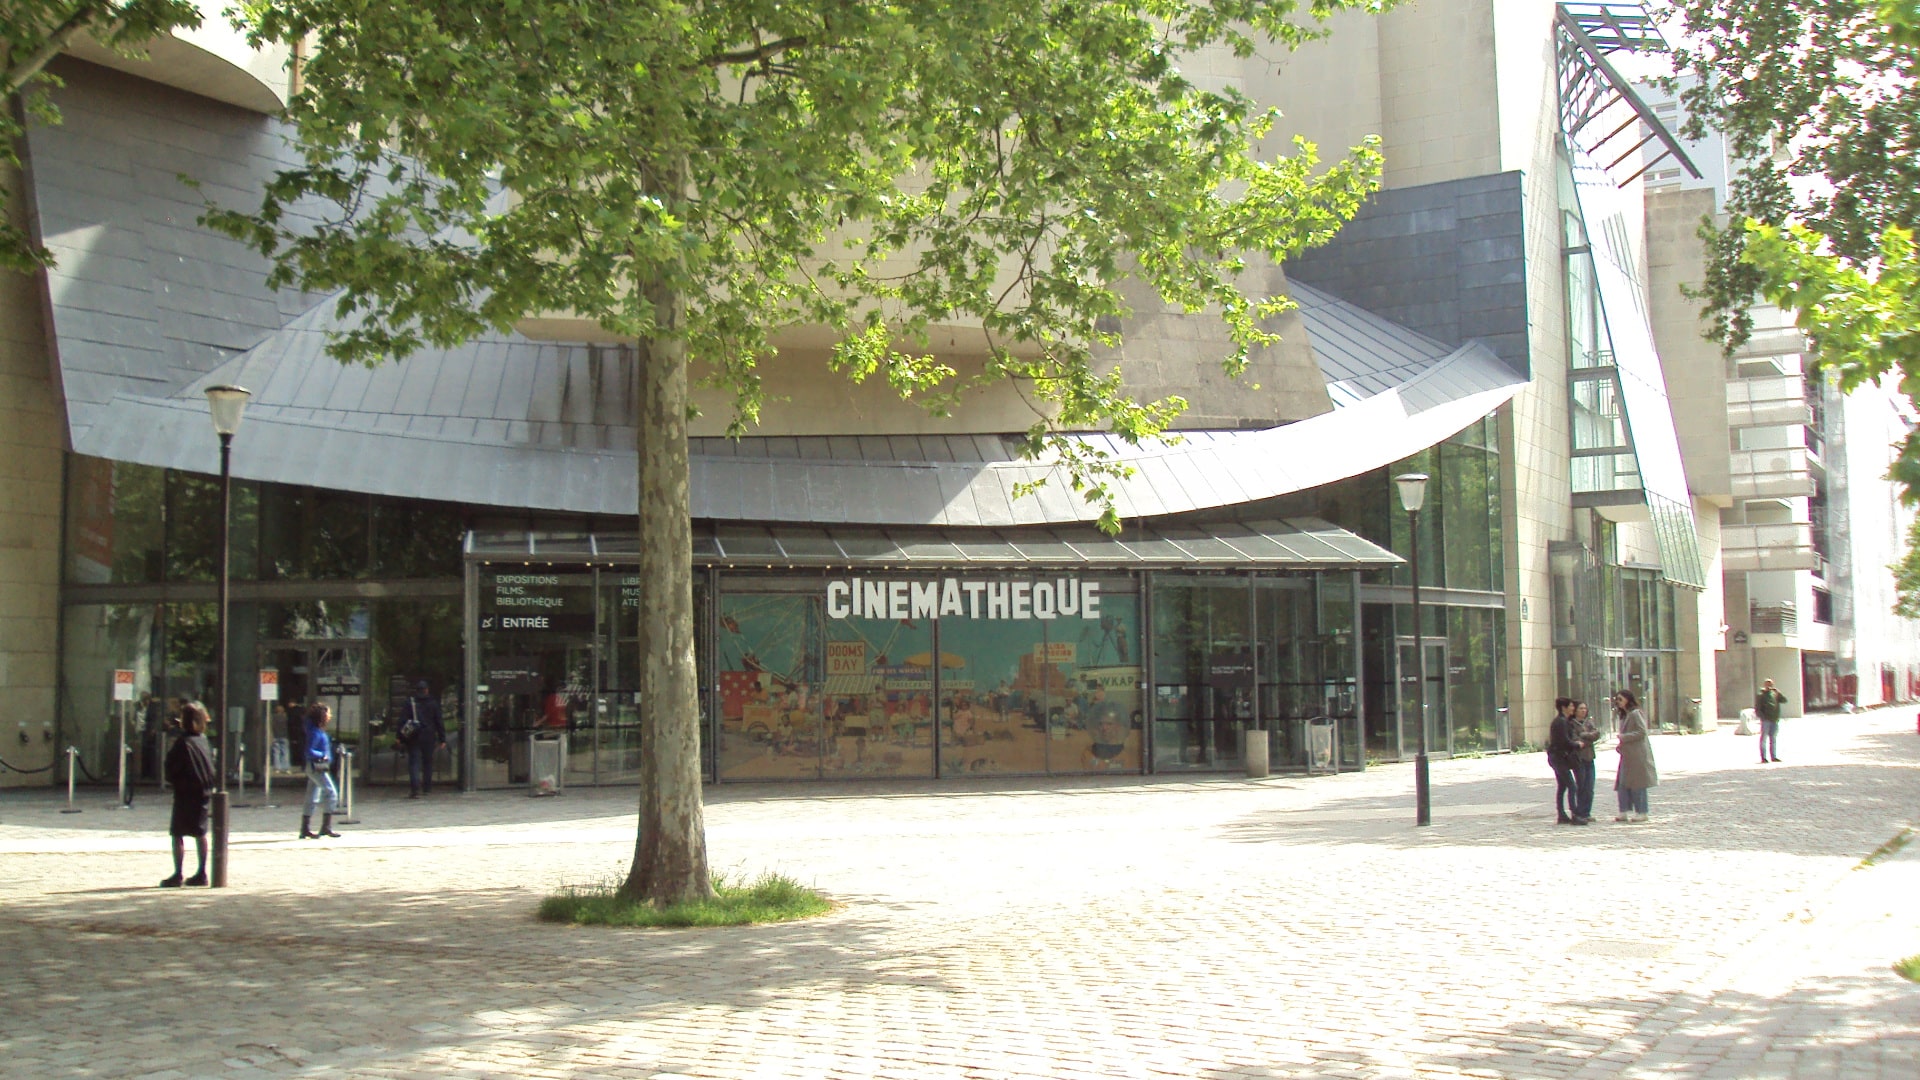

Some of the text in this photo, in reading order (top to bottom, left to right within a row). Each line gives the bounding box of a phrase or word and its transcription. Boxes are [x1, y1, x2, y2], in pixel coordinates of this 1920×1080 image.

[496, 575, 558, 584] EXPOSITIONS
[496, 586, 524, 595] FILMS
[496, 597, 564, 607] BIBLIOTHÈQUE
[827, 577, 1100, 619] CINEMATHEQUE
[503, 616, 549, 628] ENTRÉE
[829, 645, 863, 656] DOOMS
